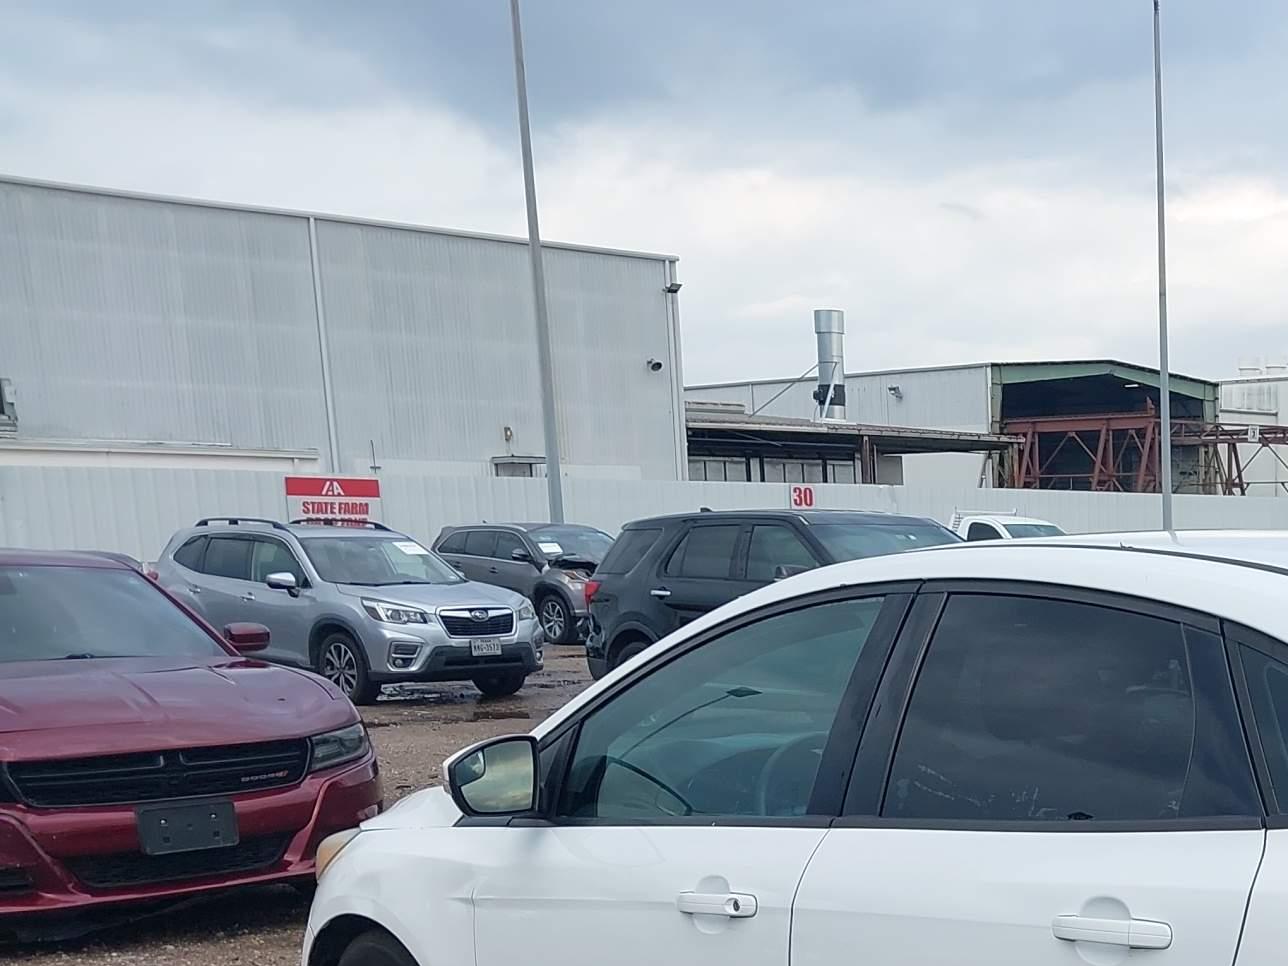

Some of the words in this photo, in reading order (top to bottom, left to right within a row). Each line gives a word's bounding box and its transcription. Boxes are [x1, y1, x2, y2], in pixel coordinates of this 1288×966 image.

[793, 487, 813, 507] 30
[302, 501, 337, 514] STATE
[338, 502, 369, 515] FARM
